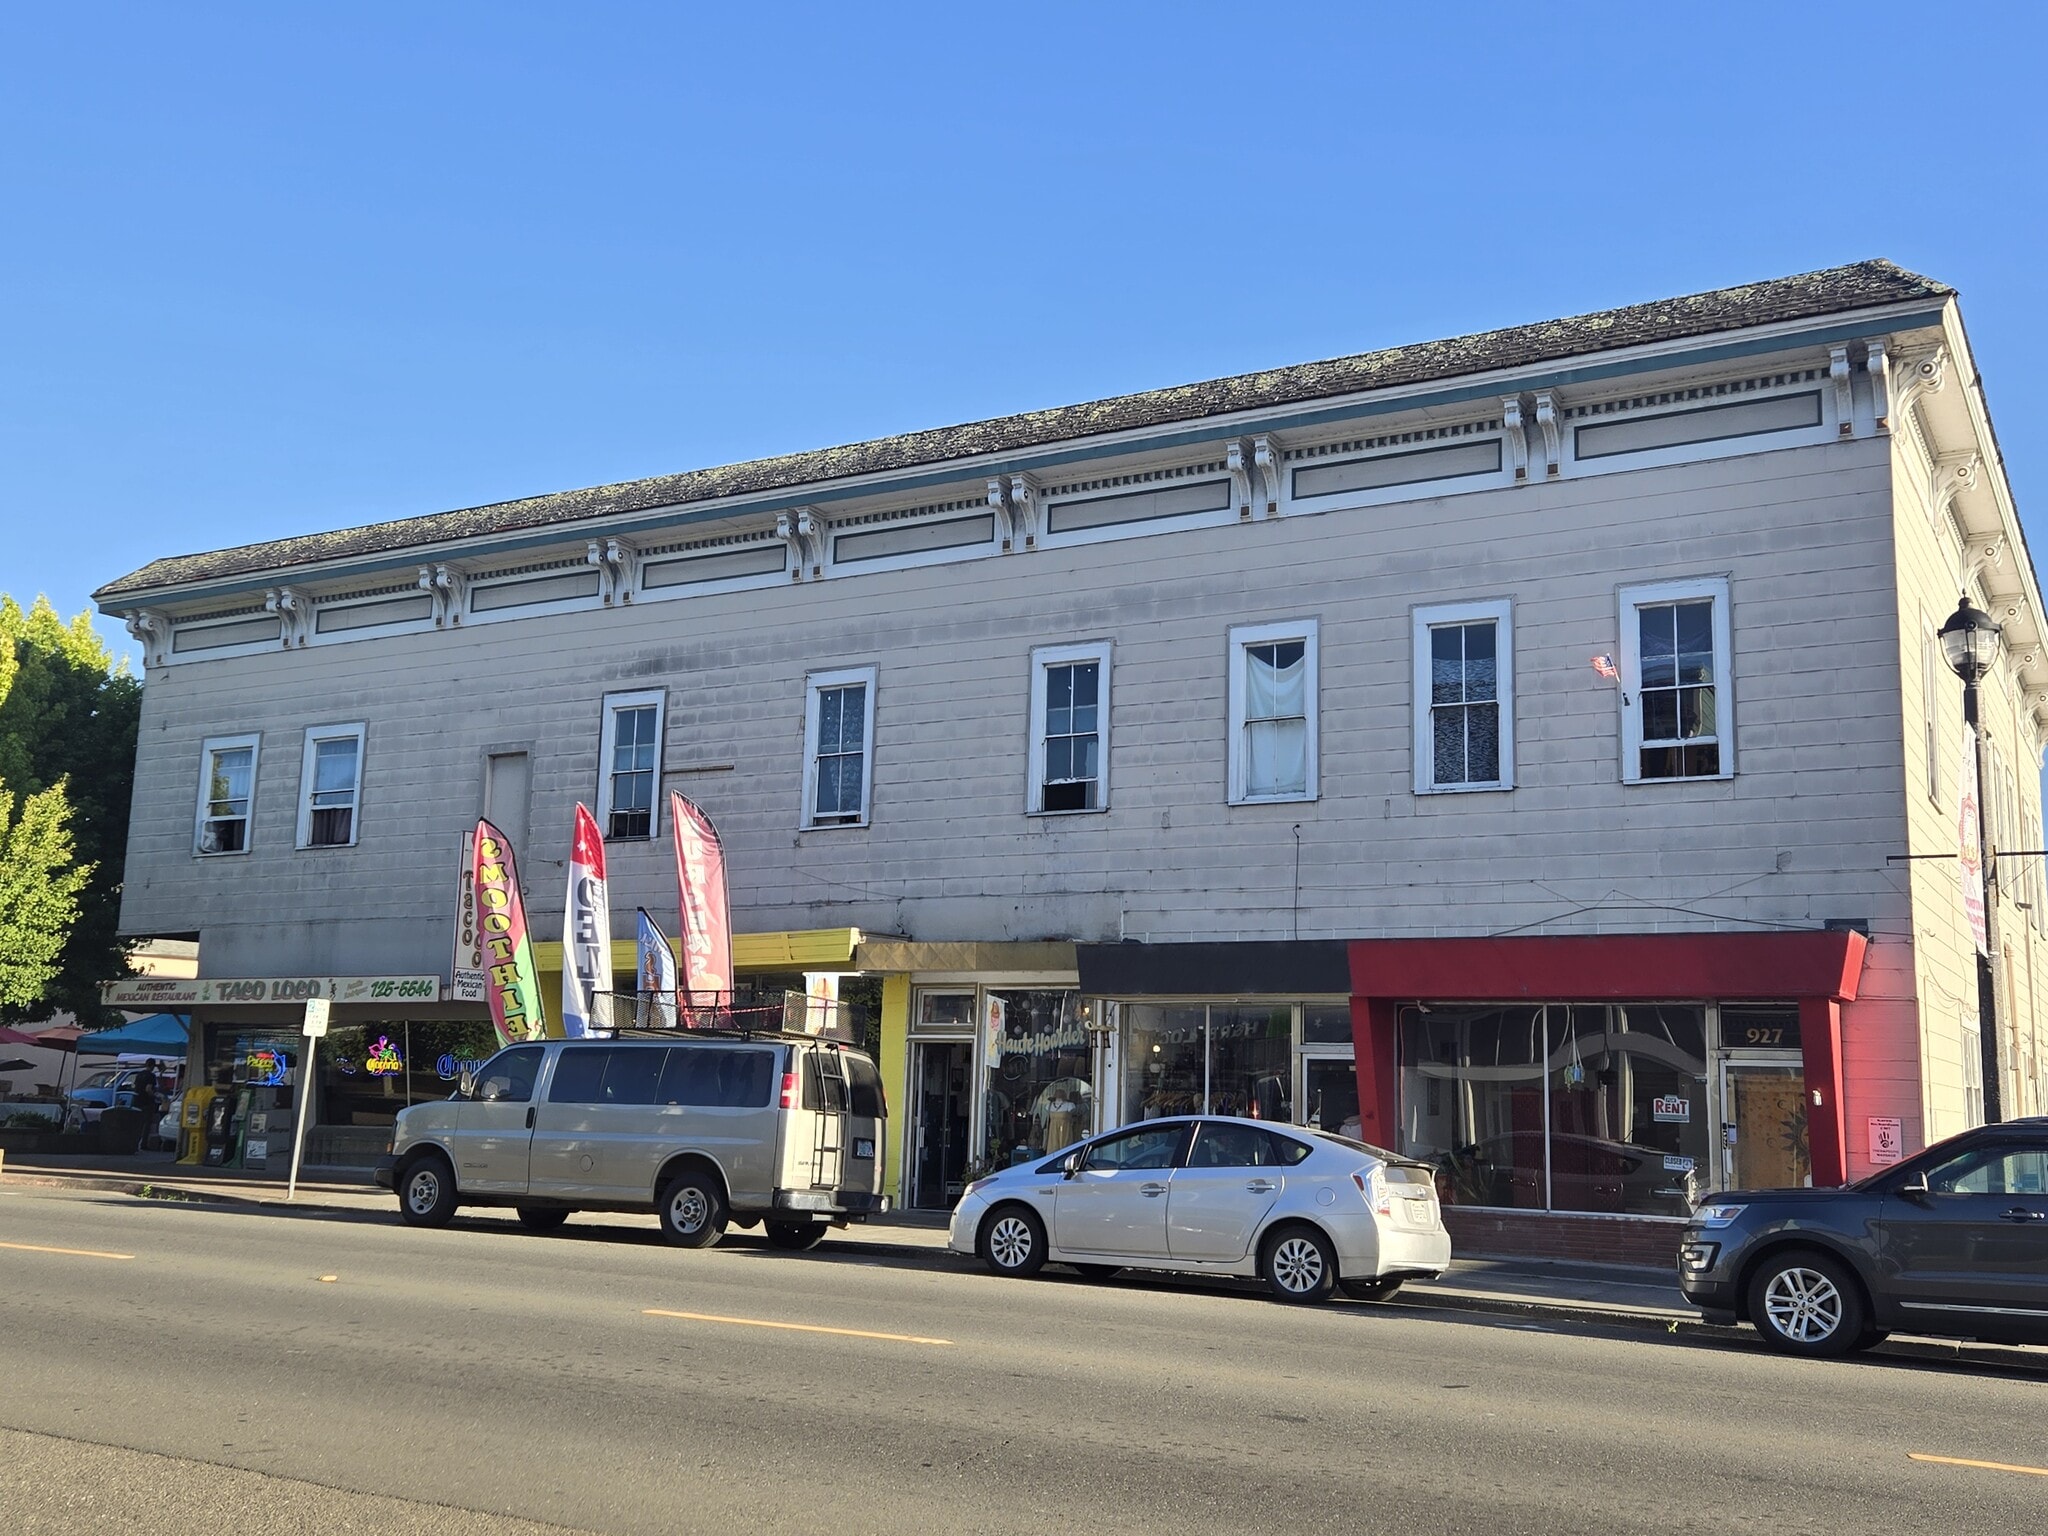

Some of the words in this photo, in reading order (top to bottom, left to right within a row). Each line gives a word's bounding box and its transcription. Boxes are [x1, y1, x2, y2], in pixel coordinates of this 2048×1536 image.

[462, 870, 474, 946] Taco
[455, 970, 485, 982] Authentic
[136, 982, 177, 991] AUTHENTIC
[216, 980, 266, 1001] TACO
[271, 979, 321, 1001] LOCO
[457, 980, 483, 989] Mexican
[114, 991, 150, 1001] MEXICAN
[151, 991, 197, 1002] RESTAURANT
[461, 988, 477, 998] Food
[1746, 1028, 1783, 1044] 927
[366, 1057, 400, 1072] Corona
[1655, 1099, 1687, 1115] RENT
